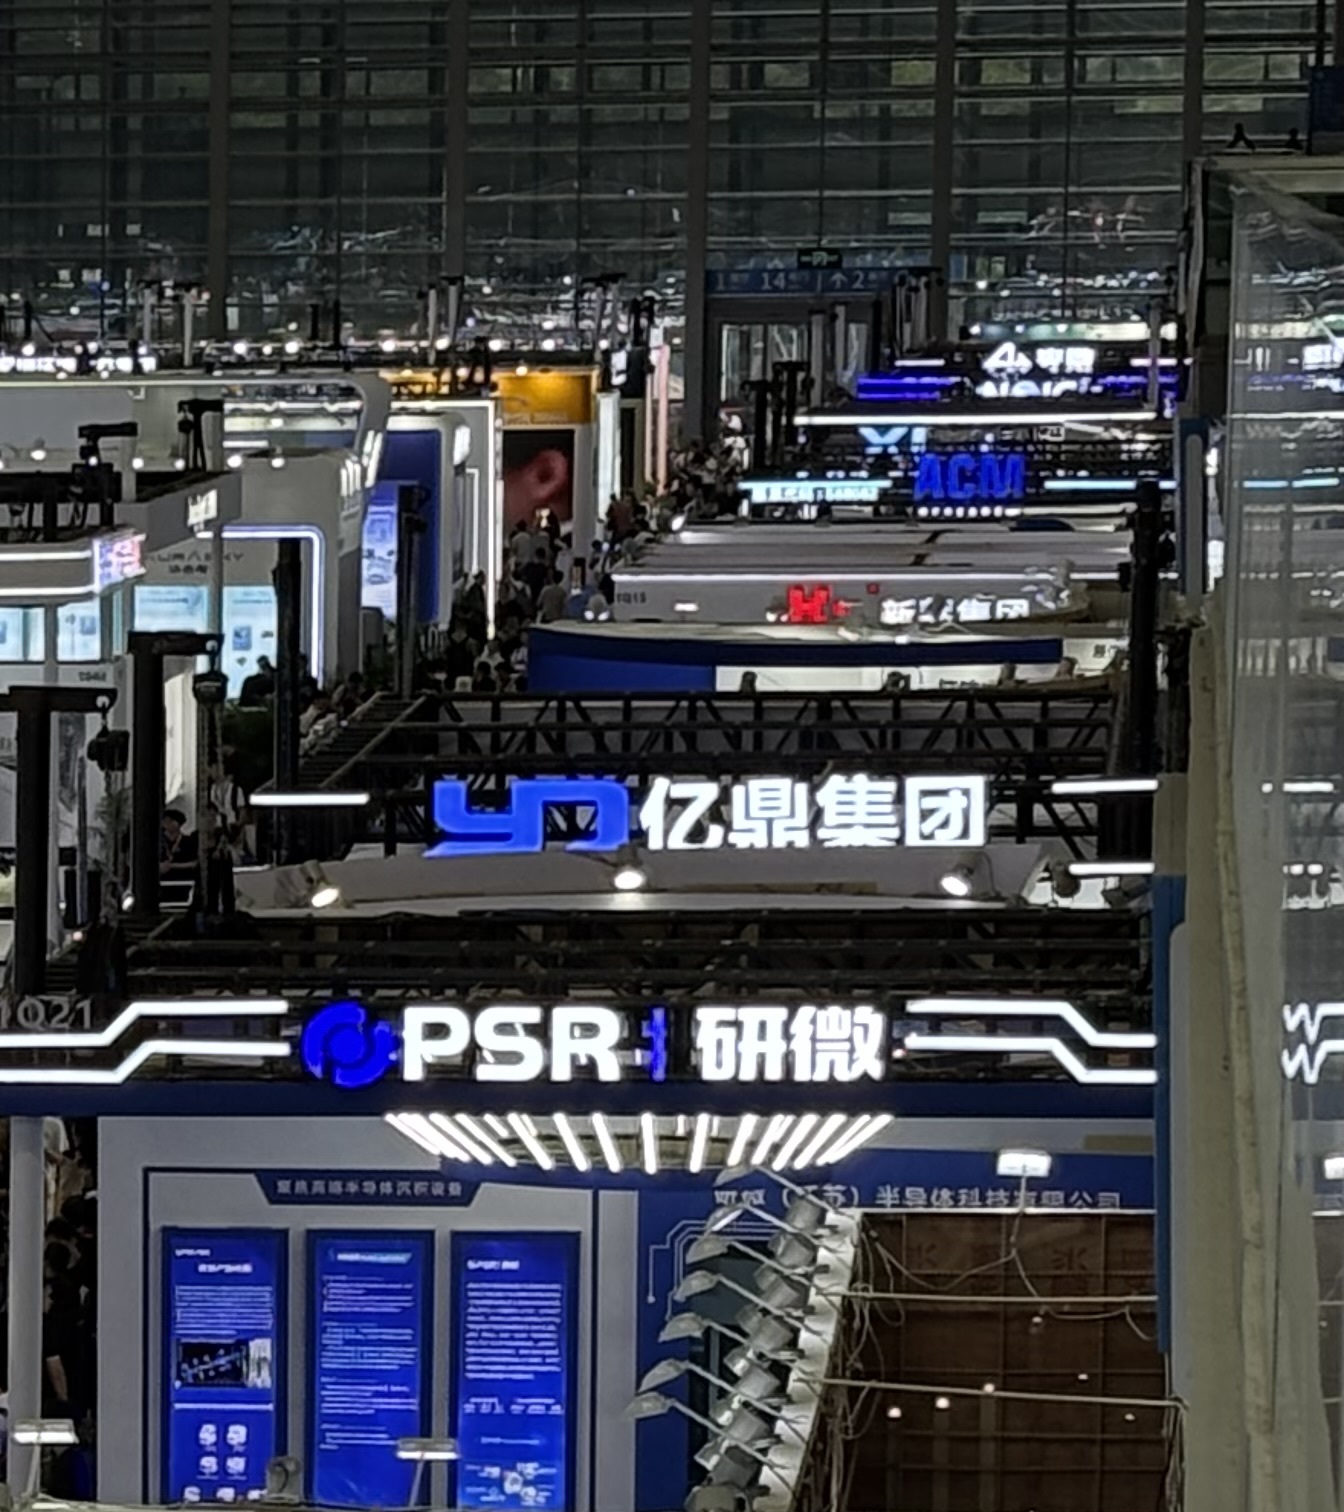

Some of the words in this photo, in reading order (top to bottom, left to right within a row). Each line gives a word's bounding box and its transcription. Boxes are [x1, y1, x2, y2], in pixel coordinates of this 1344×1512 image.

[915, 453, 1025, 500] ACM
[639, 773, 987, 851] 亿鼎集团
[401, 1005, 621, 1083] PSR
[695, 1005, 887, 1082] 研微
